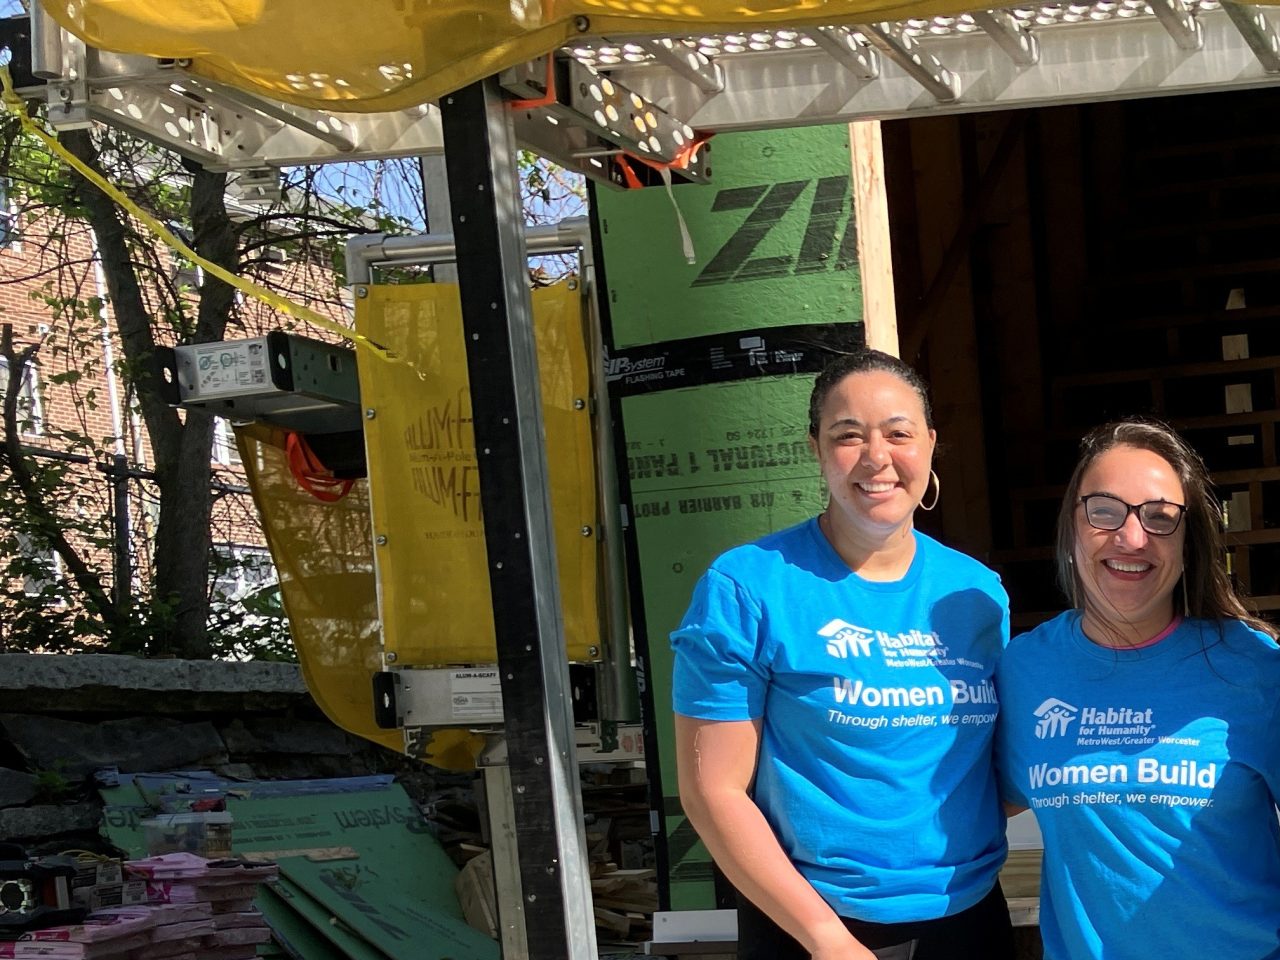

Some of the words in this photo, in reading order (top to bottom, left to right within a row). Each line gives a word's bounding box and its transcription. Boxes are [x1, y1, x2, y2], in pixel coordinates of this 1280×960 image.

[625, 372, 664, 385] FLASHING
[665, 368, 686, 378] TAPE
[679, 495, 742, 515] BARRIER
[875, 629, 943, 649] Habitat
[833, 677, 944, 707] Women
[828, 710, 888, 730] Through
[891, 714, 938, 727] shelter,
[941, 715, 959, 725] we
[1080, 707, 1153, 725] Habitat
[1079, 725, 1096, 736] for
[1098, 725, 1151, 736] Humanity
[1076, 737, 1156, 747] MetroWest/Greater
[1157, 735, 1201, 747] Worcester
[1028, 762, 1128, 790] Women
[1137, 758, 1216, 789] Build
[1031, 792, 1070, 809] Through
[1072, 791, 1123, 805] shelter,
[1126, 793, 1147, 804] we
[1150, 794, 1215, 808] empower.
